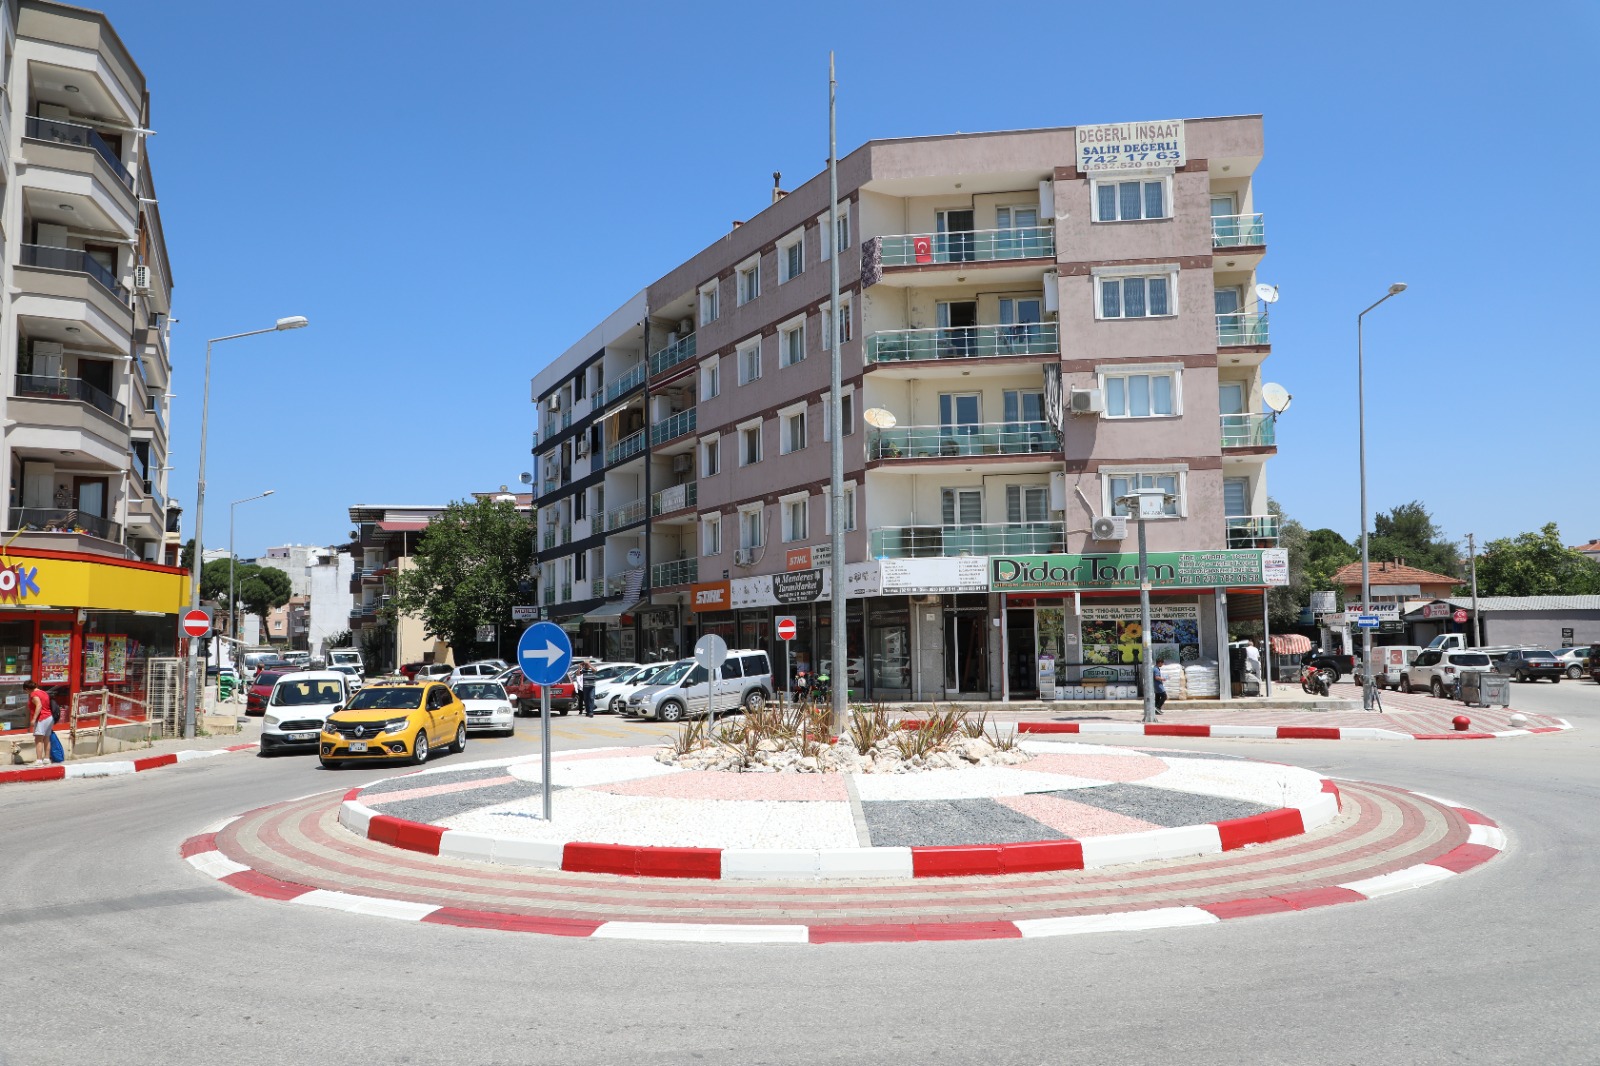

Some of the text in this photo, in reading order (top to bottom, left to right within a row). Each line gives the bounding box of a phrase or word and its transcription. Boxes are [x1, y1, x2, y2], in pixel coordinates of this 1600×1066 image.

[1080, 123, 1180, 143] DEĞERLİ İNŞAAT
[1083, 140, 1178, 155] SALİH DEĞERLİ
[1082, 151, 1180, 164] 742 17 63
[993, 559, 1082, 583] Didar
